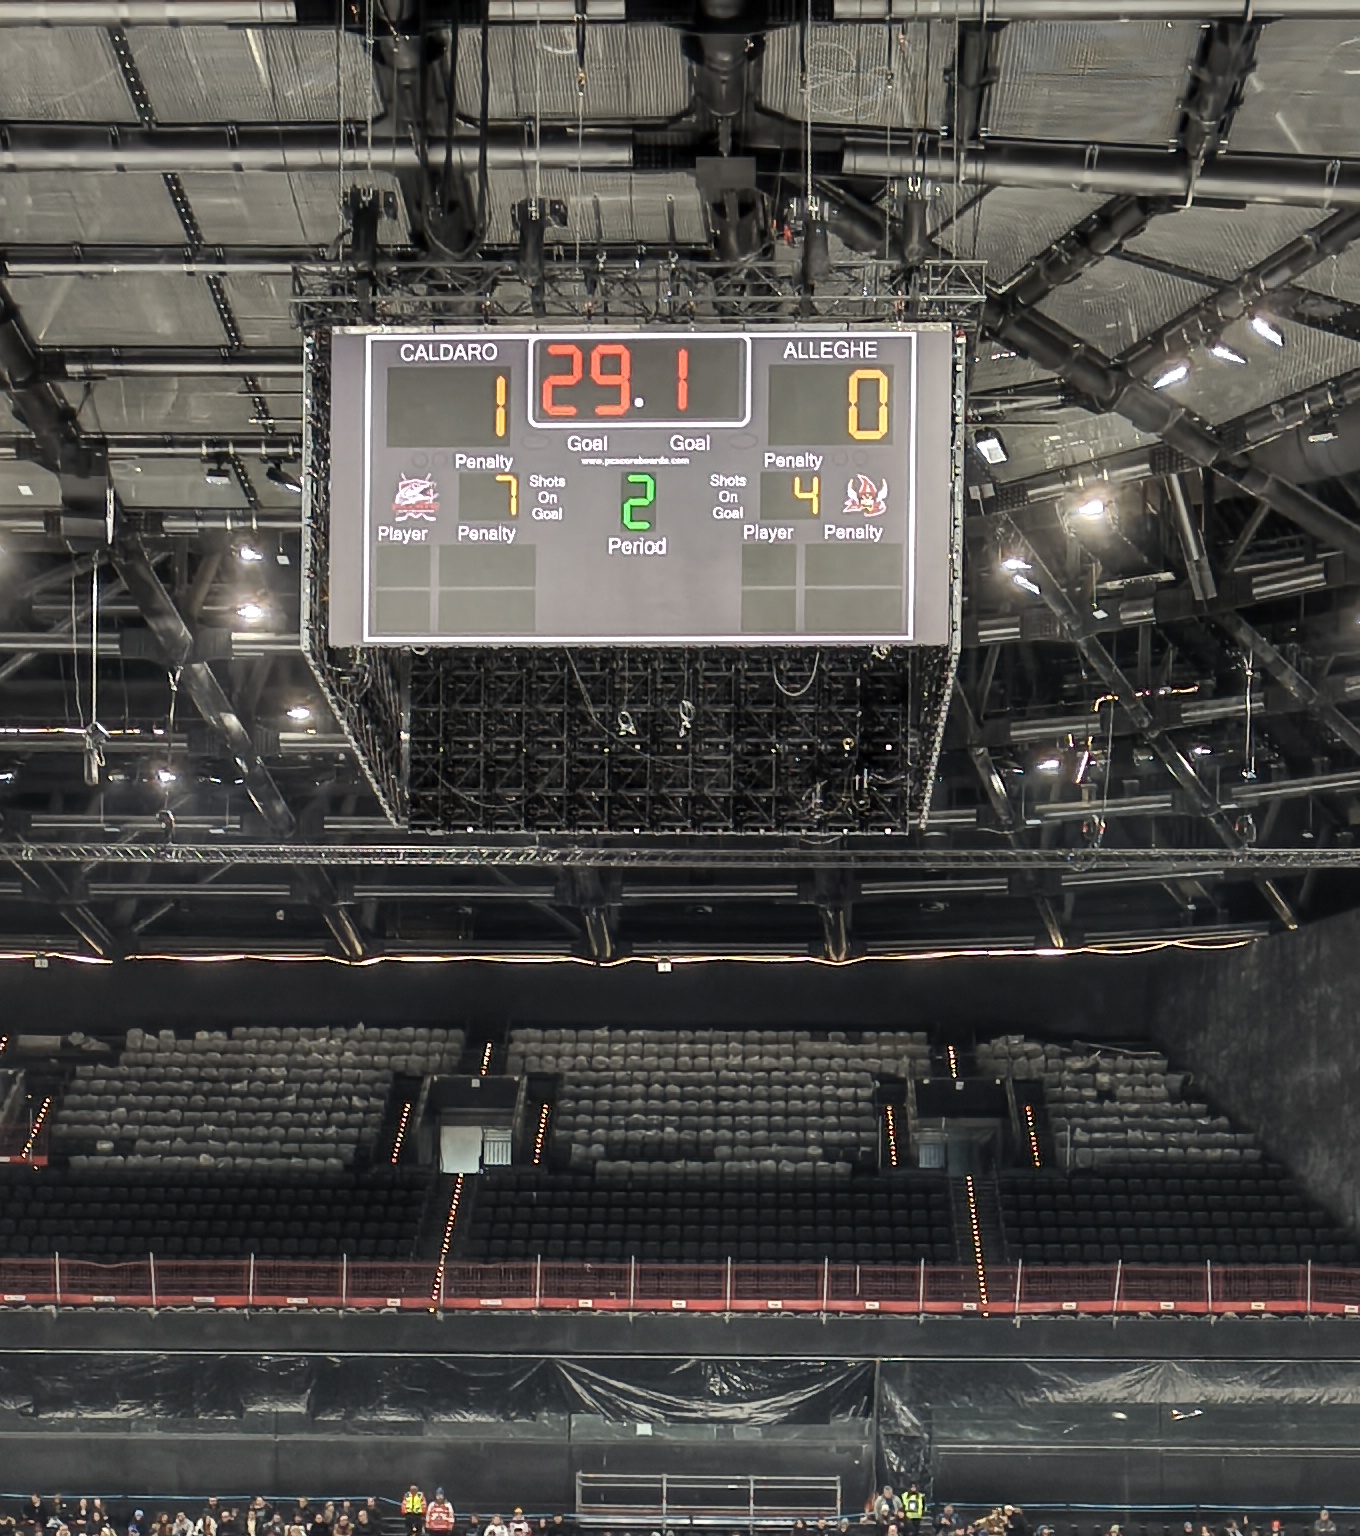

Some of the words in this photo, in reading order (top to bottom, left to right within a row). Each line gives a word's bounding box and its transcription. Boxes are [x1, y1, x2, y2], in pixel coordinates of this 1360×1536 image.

[400, 342, 498, 362] CALDARO
[783, 341, 878, 360] ALLEGHE
[495, 375, 506, 438] 1
[848, 369, 888, 440] 0
[567, 435, 608, 452] Goal
[669, 434, 711, 451] Goal
[455, 453, 513, 472] Penalty
[764, 451, 823, 470] Penalty
[529, 474, 566, 488] Shots
[710, 473, 747, 487] Shots
[495, 474, 518, 516] 7
[537, 490, 558, 504] On
[623, 474, 655, 530] 2
[718, 490, 739, 503] On
[794, 476, 820, 515] 4
[531, 507, 563, 521] Goal
[712, 506, 744, 520] Goal
[378, 525, 429, 545] Player
[457, 525, 517, 544] Penalty
[743, 523, 795, 543] Player
[823, 523, 884, 543] Penalty
[608, 537, 667, 555] Period
